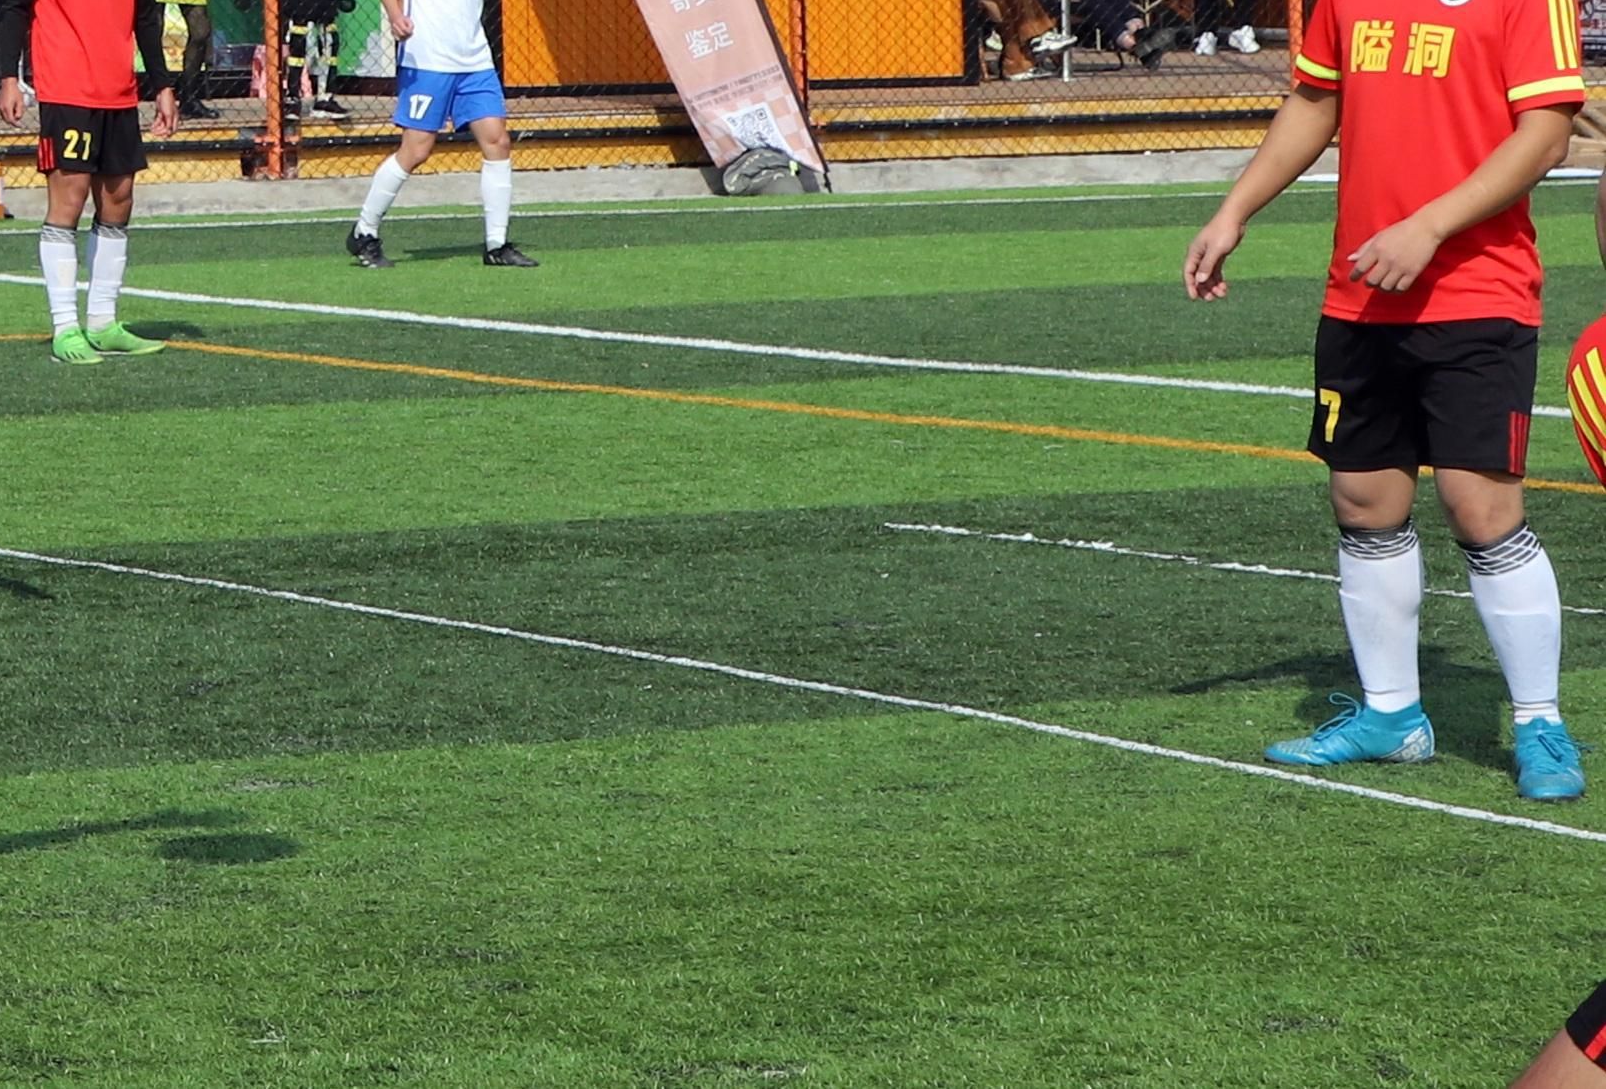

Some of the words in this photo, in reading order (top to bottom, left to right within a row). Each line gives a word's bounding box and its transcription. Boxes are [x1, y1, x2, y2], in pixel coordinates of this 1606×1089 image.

[685, 21, 734, 59] 鉴定
[408, 93, 432, 120] 17
[1319, 387, 1342, 443] 7
